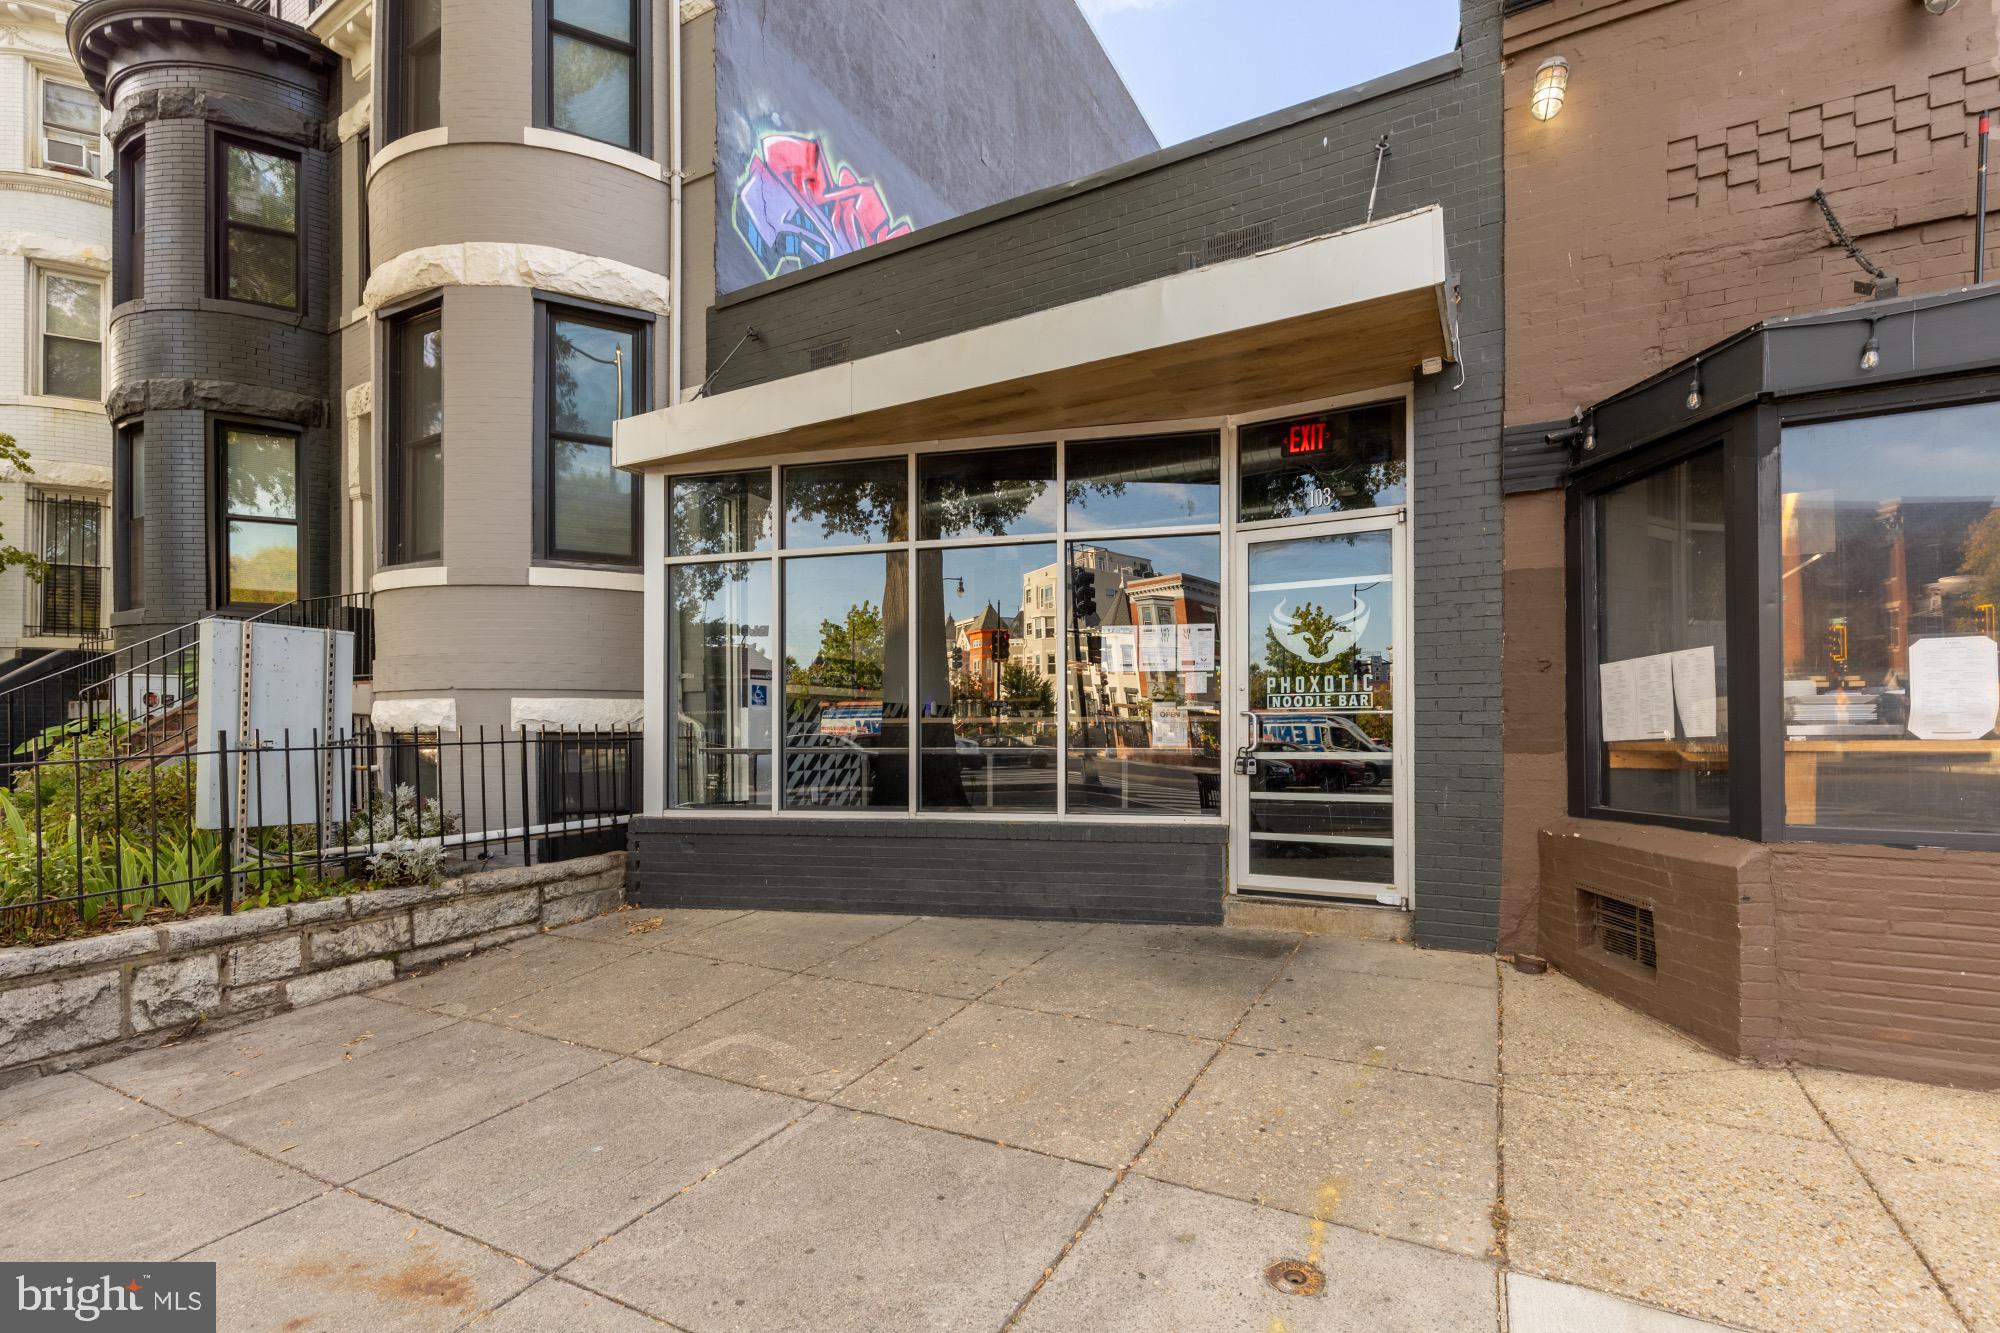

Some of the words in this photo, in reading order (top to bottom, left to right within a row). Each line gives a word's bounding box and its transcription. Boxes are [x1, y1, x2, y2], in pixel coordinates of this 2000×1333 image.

[1288, 423, 1327, 454] EXIT
[1309, 487, 1332, 508] 103
[1266, 673, 1374, 694] PHOXOTIC
[1272, 695, 1332, 708] NOODLE
[1338, 694, 1370, 707] BAR
